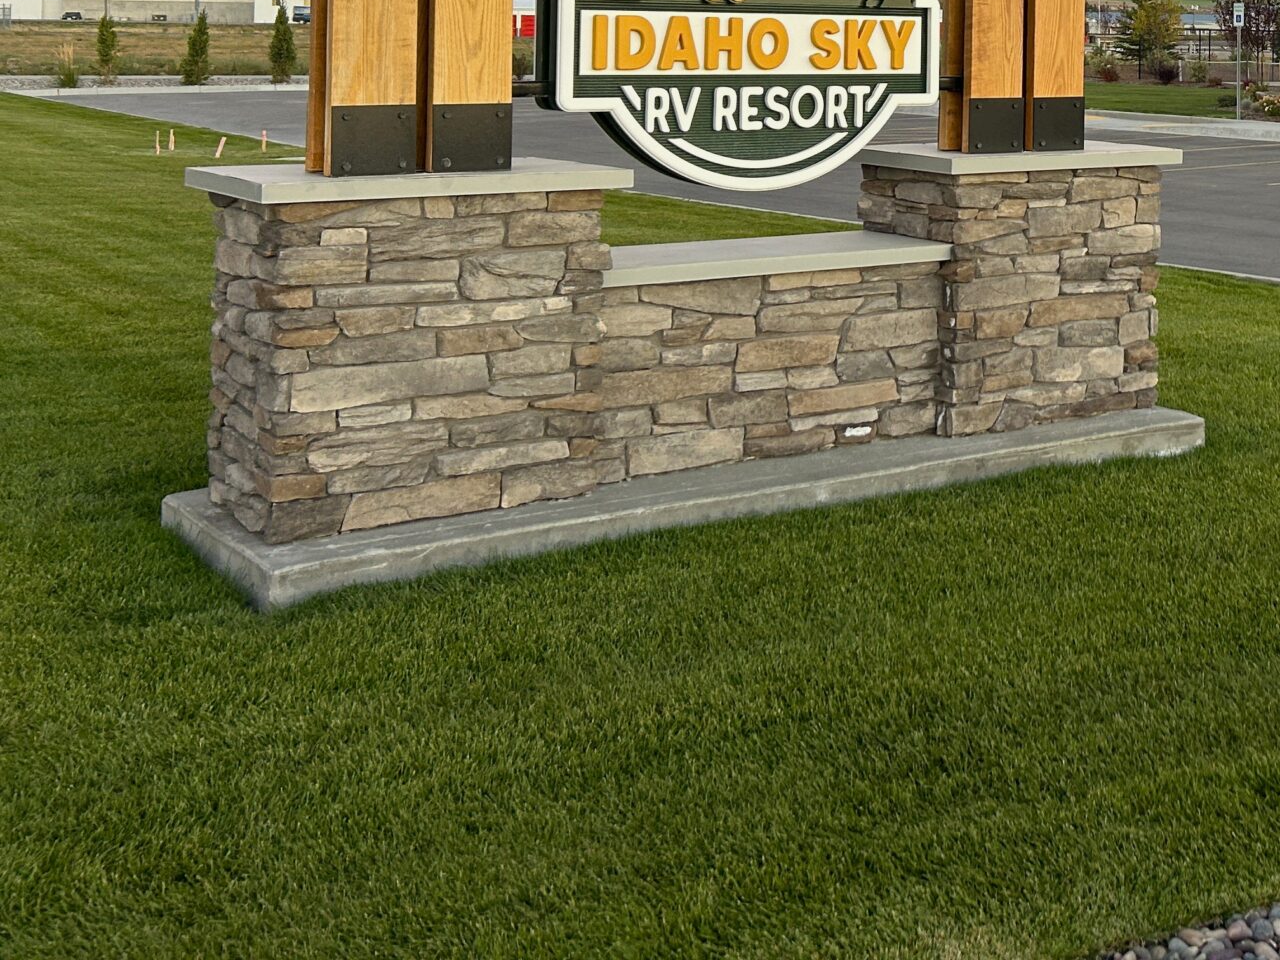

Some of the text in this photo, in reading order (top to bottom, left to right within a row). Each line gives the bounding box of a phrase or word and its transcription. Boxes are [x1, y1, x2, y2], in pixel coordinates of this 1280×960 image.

[592, 14, 916, 71] IDAHO SKY
[644, 84, 870, 133] RV RESORT
